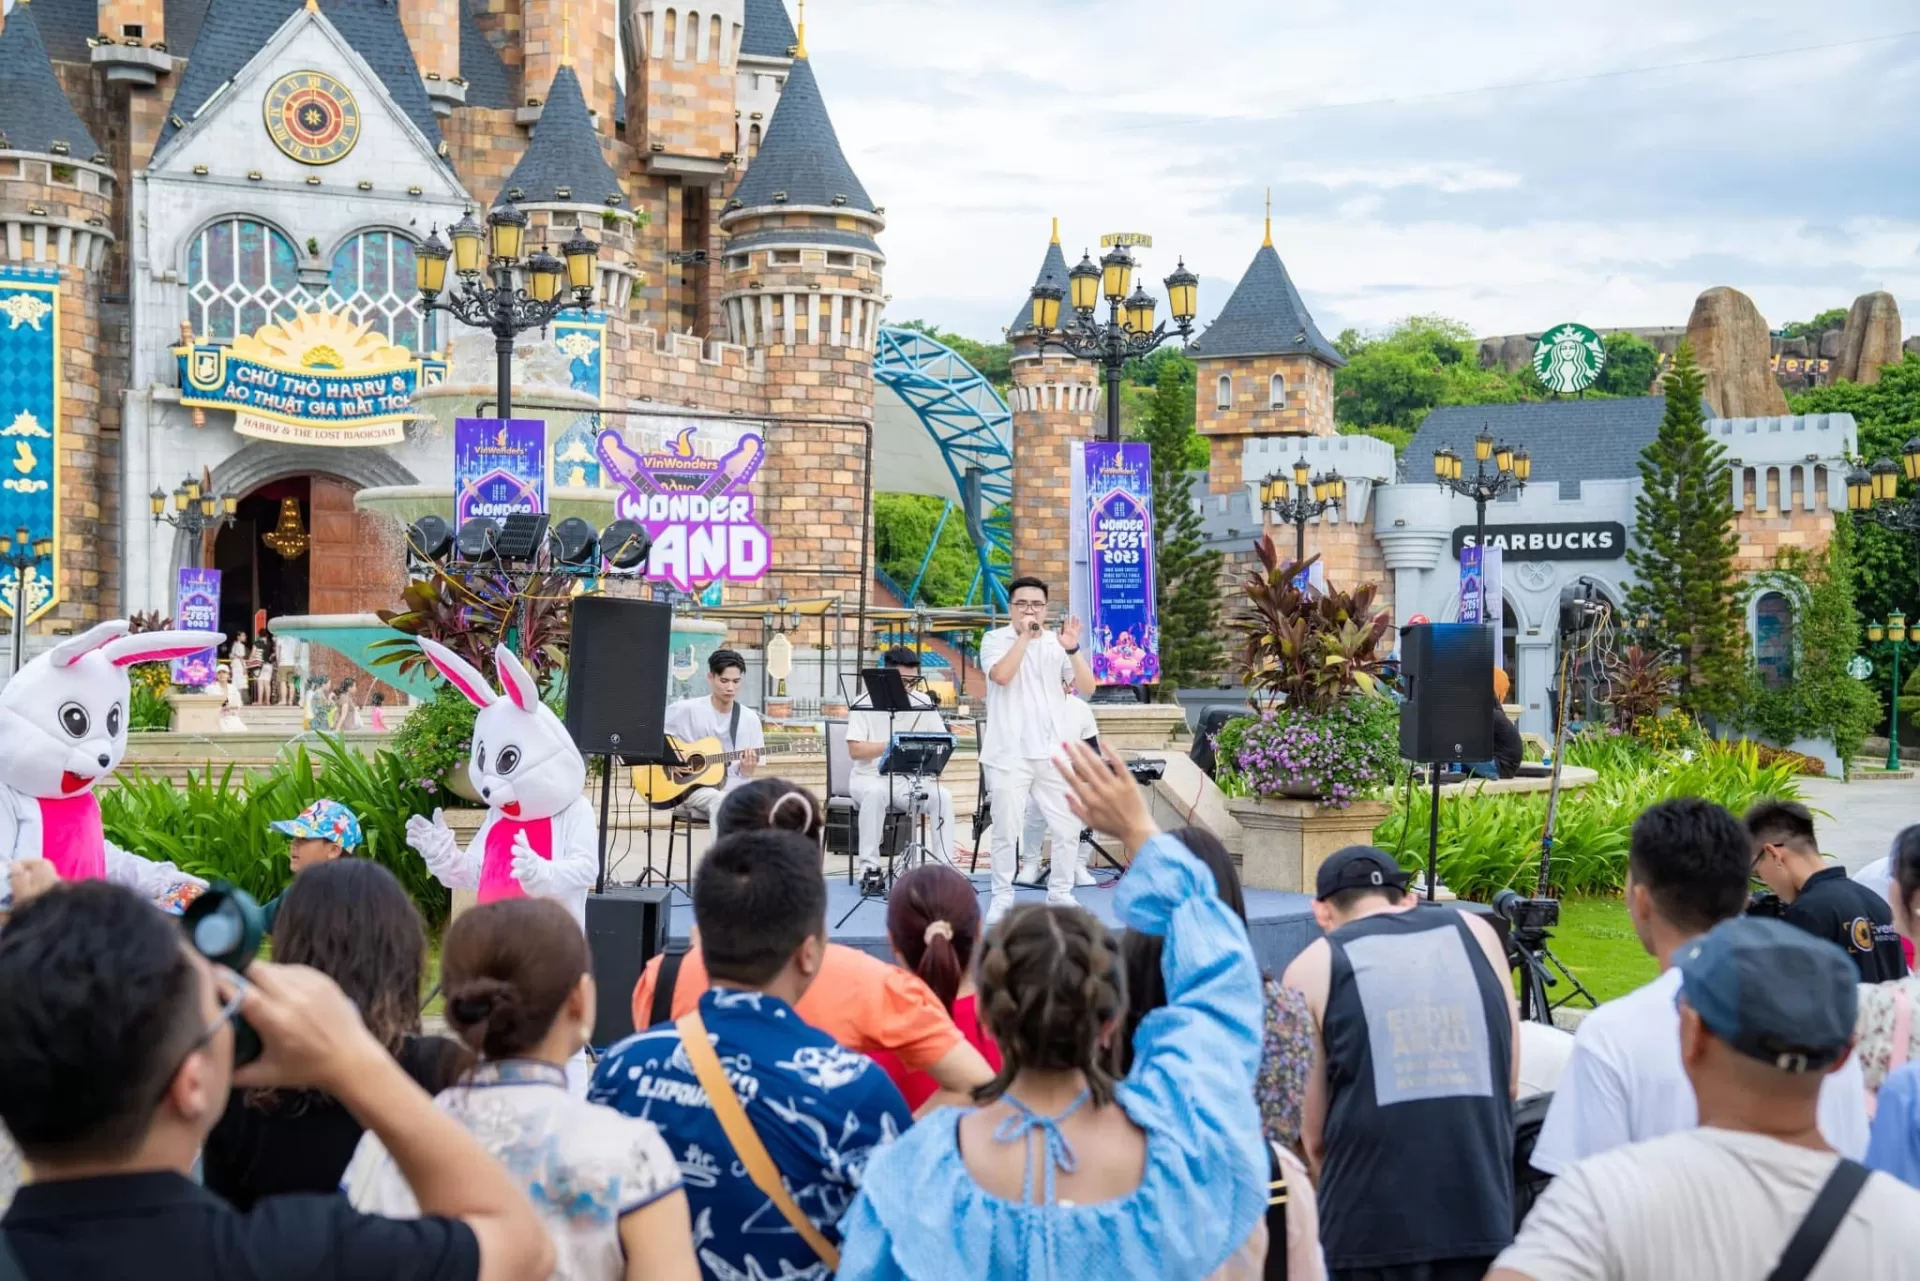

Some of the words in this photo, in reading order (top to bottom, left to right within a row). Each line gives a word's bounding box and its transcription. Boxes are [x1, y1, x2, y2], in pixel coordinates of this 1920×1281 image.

[236, 366, 279, 388] CHÚ
[326, 379, 386, 398] HARRY
[391, 376, 406, 392] &
[308, 401, 337, 416] GIA
[243, 417, 279, 433] HARRY
[293, 427, 312, 438] THE
[315, 430, 341, 440] LOST
[344, 427, 395, 440] MAGICIAN
[643, 456, 719, 470] VinWonders
[622, 494, 750, 523] WONDER
[1099, 519, 1144, 531] WONDER
[1463, 531, 1613, 550] STARBUCKS
[608, 525, 768, 588] AND
[1104, 550, 1140, 564] 2023
